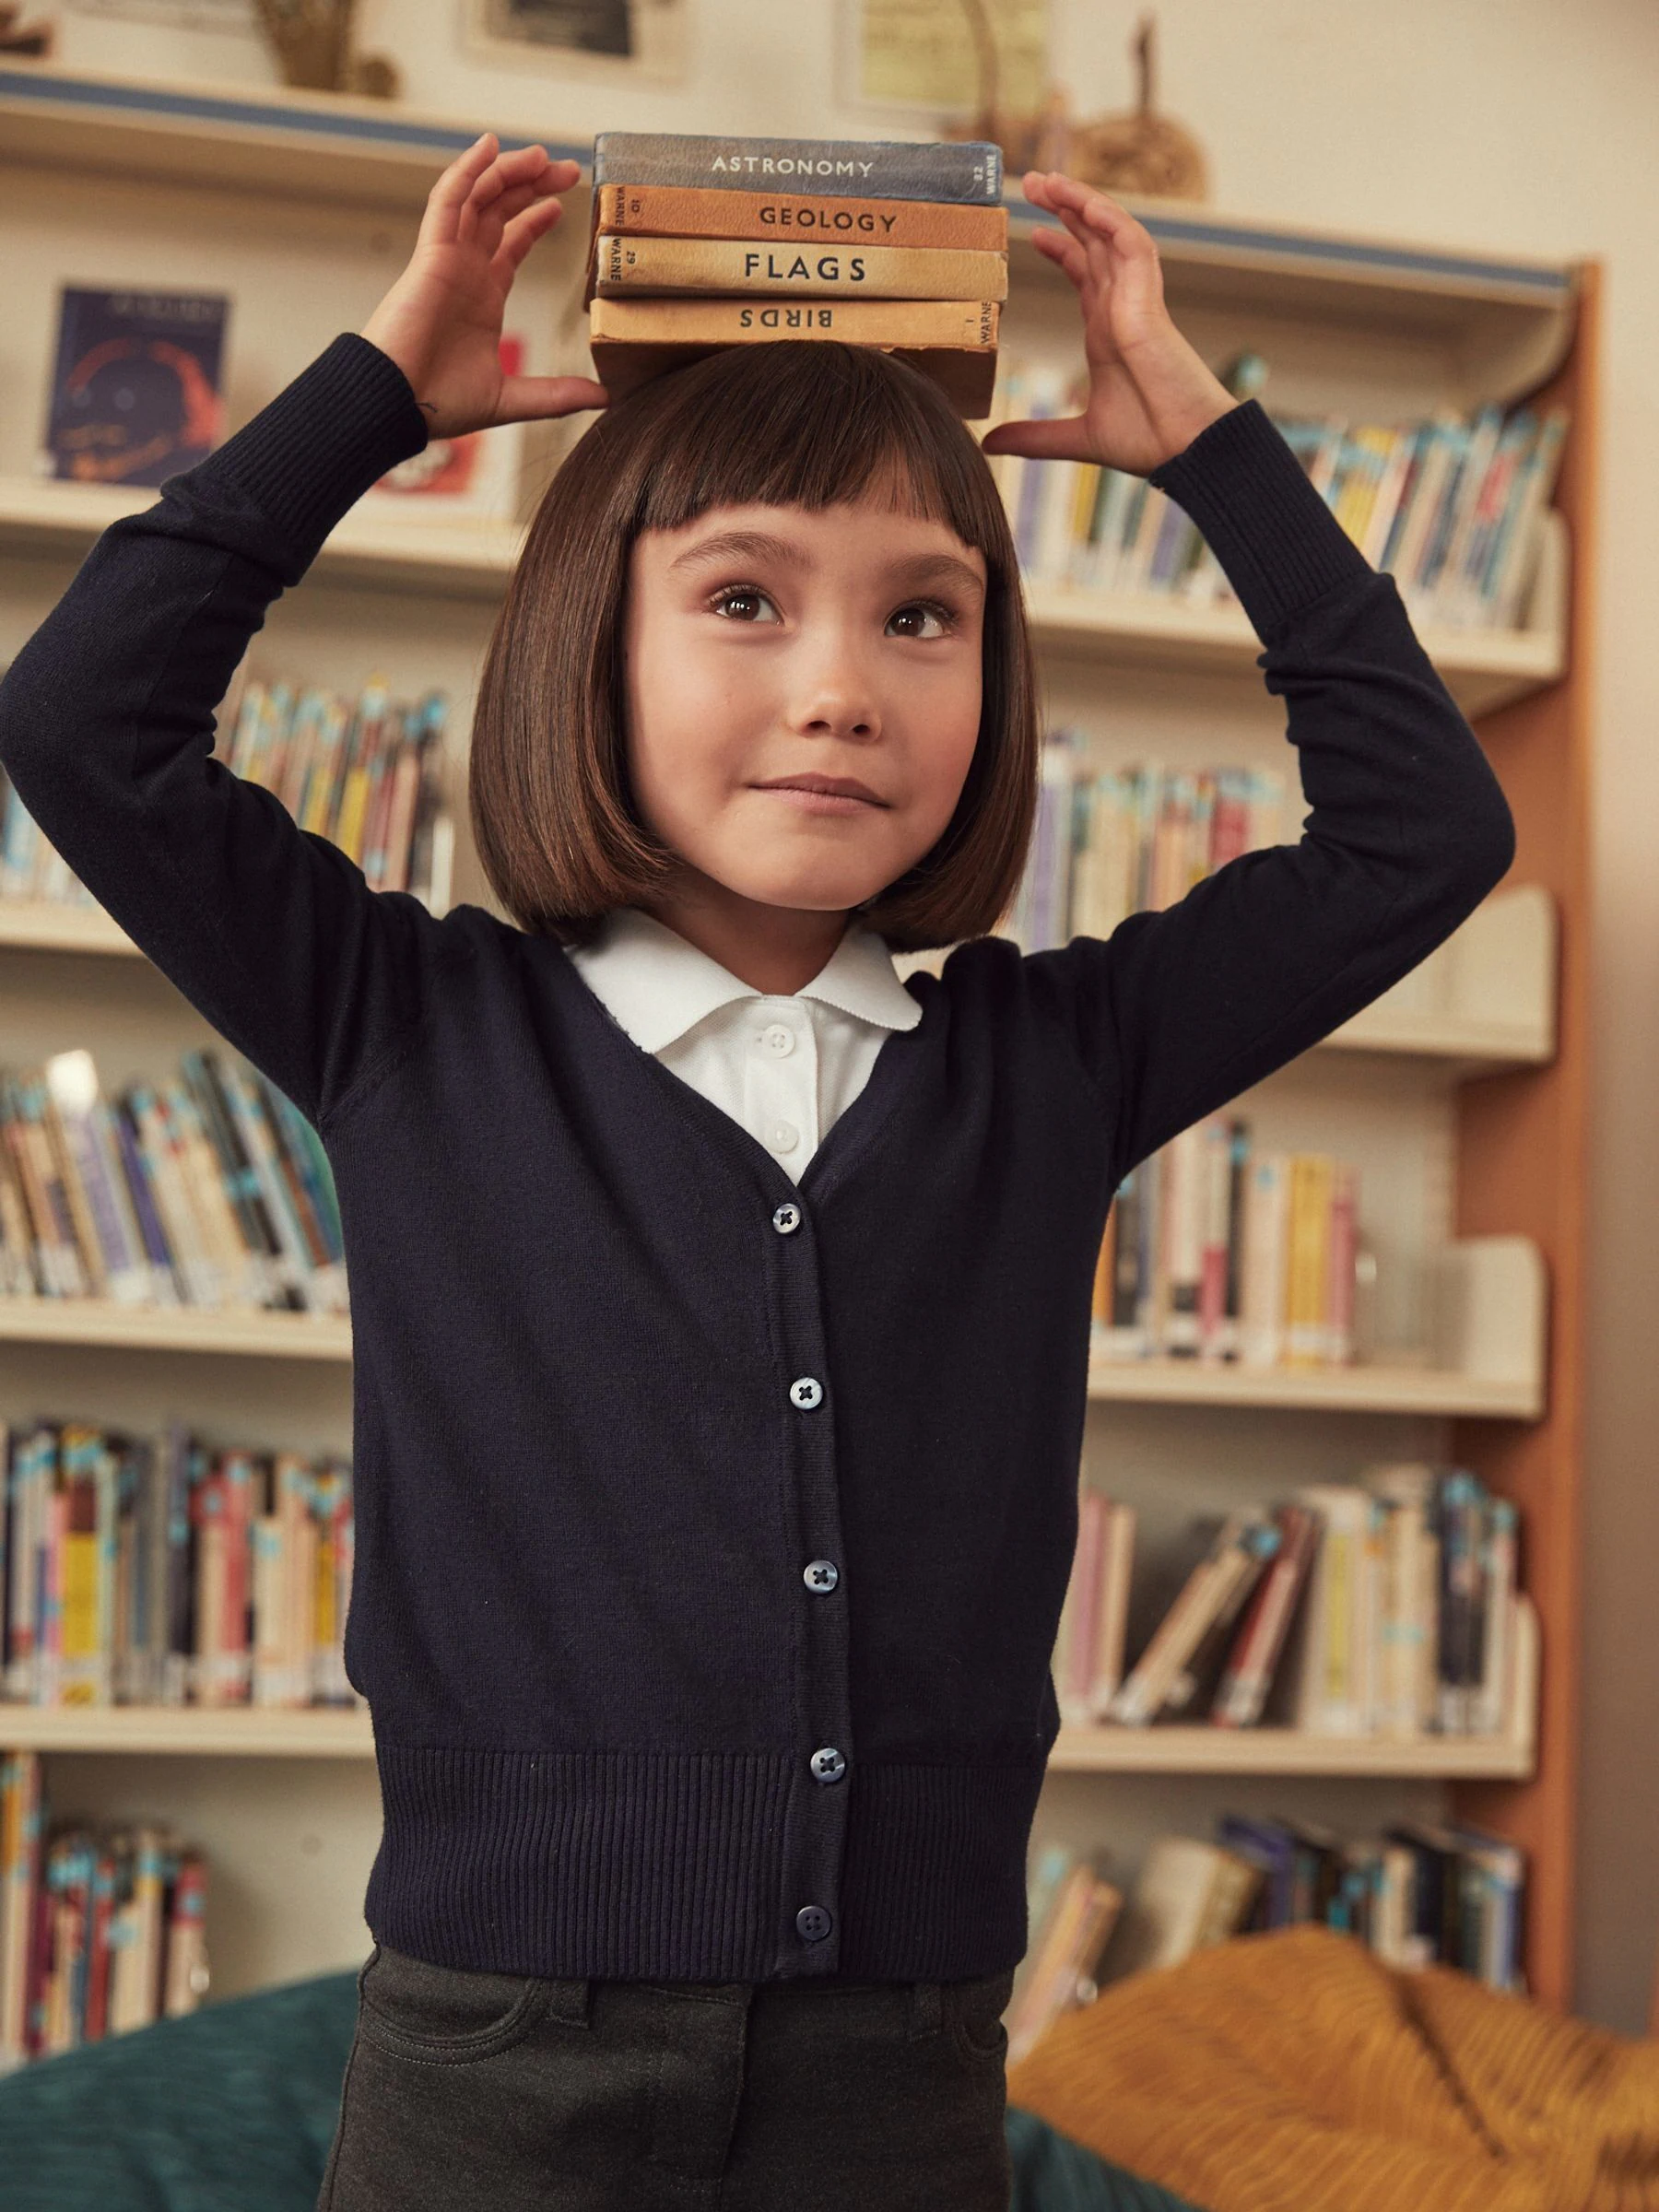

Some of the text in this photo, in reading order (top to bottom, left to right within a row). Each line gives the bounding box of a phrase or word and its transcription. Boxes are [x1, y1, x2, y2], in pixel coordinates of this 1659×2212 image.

[712, 156, 874, 178] ASTRONOMY
[986, 154, 996, 194] WARNE
[615, 186, 626, 227] WARNE
[631, 199, 641, 213] 10
[759, 206, 897, 232] GEOLOGY
[610, 238, 622, 281] WARNE
[626, 251, 636, 265] 29
[745, 253, 865, 281] FLAGS
[739, 309, 832, 328] BIRDS
[981, 301, 992, 344] WARNE
